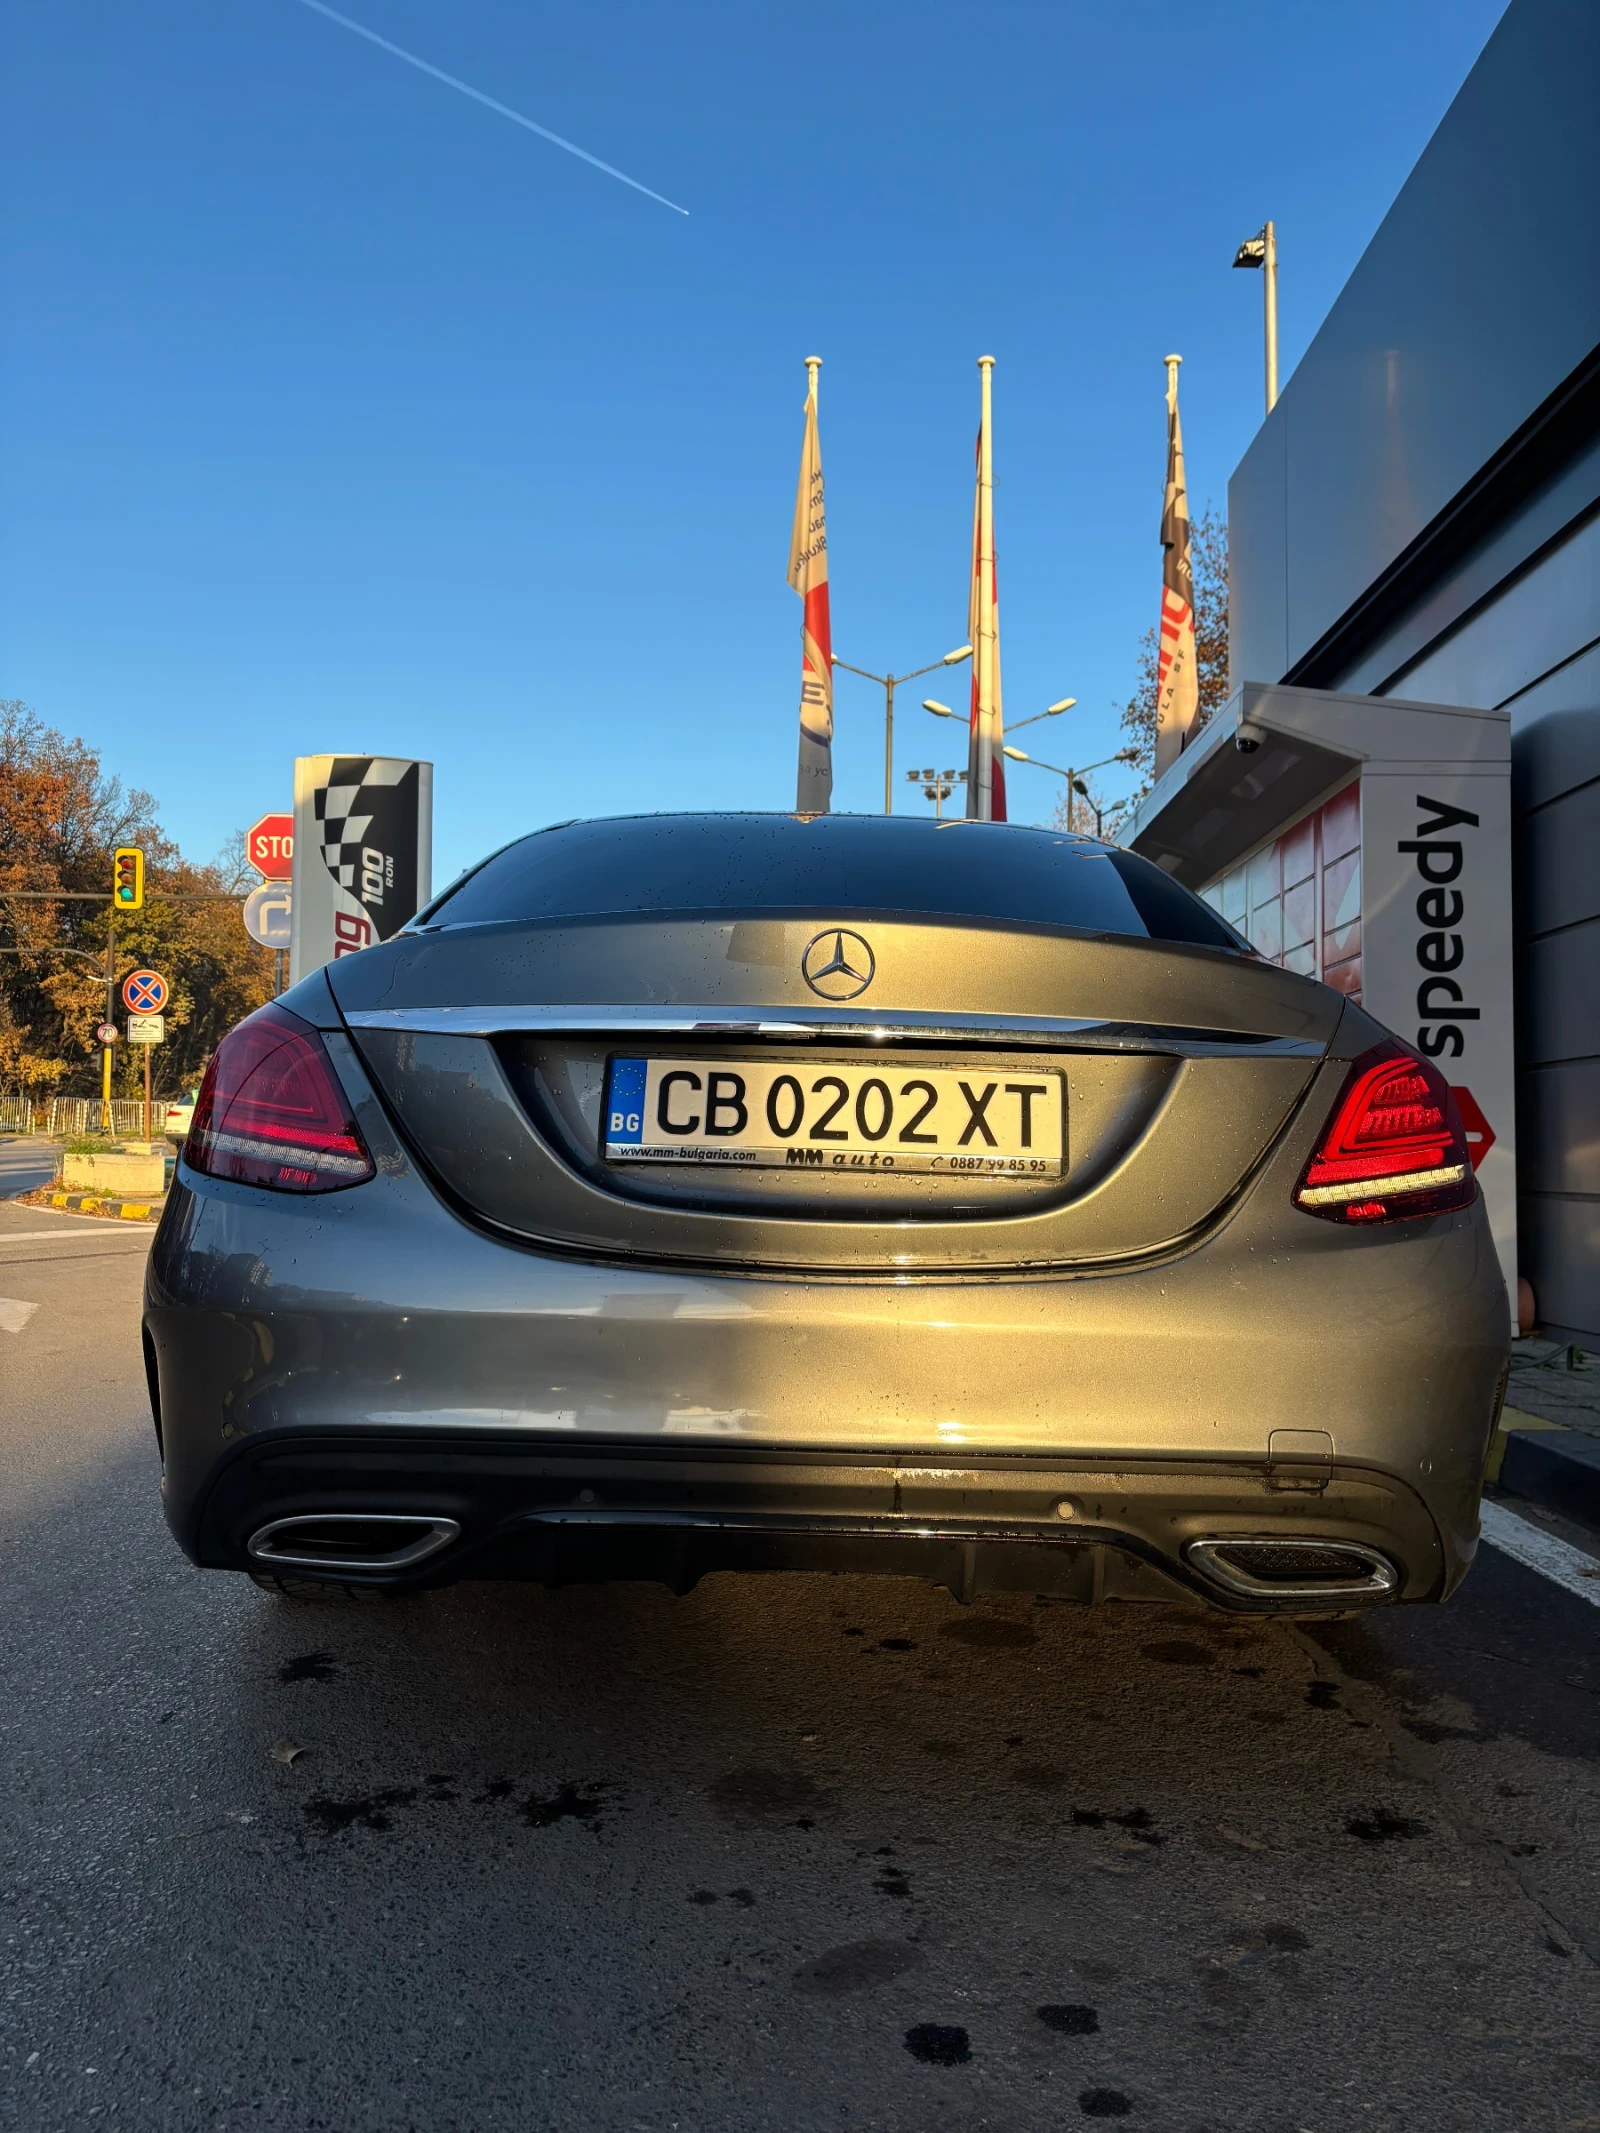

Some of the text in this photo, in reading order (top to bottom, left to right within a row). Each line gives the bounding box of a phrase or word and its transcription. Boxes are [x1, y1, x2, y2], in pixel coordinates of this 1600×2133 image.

[361, 846, 384, 906] 100
[385, 855, 394, 888] RON
[1397, 794, 1481, 1058] speedy
[102, 1028, 114, 1038] 70
[656, 1070, 1048, 1147] CB 0202 XT
[610, 1112, 640, 1132] BG
[619, 1146, 757, 1161] www.mm-bulgaria.com
[785, 1148, 895, 1167] MM auto
[950, 1156, 1046, 1173] 0887 99 85 95
